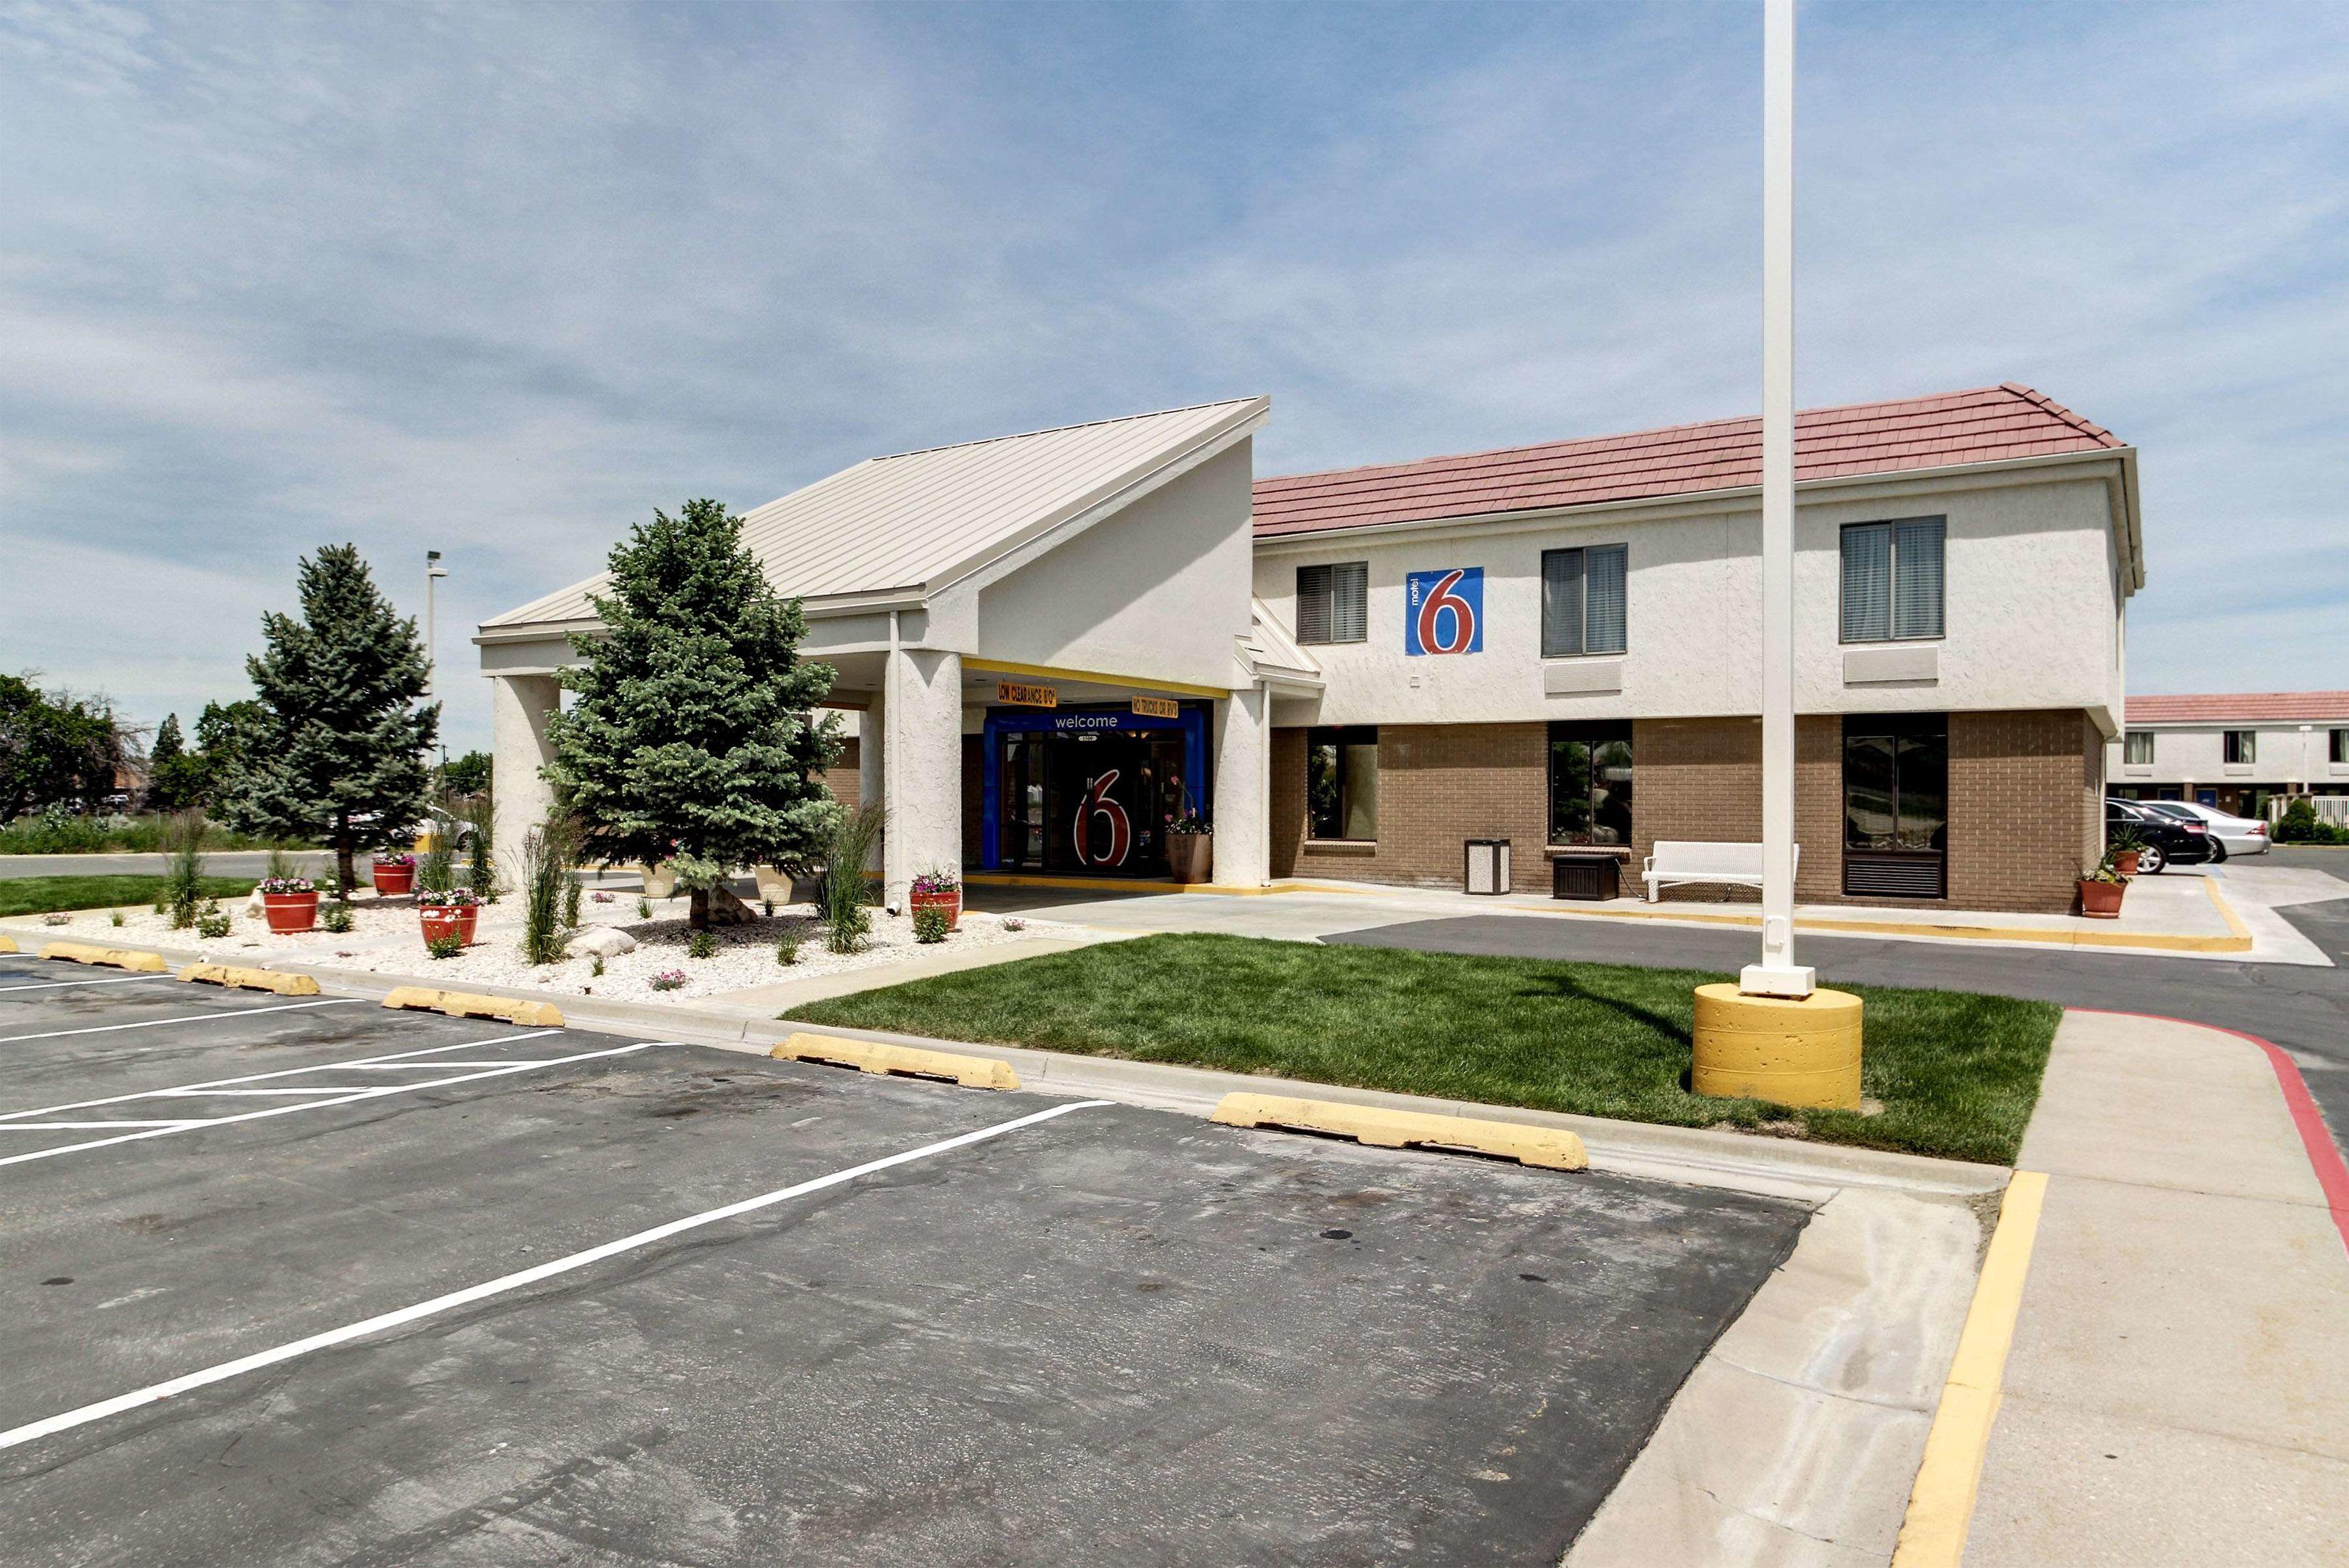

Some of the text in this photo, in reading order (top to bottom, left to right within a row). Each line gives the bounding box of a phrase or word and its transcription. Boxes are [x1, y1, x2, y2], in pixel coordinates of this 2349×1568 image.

[1418, 569, 1474, 655] 6
[999, 683, 1010, 701] LOW
[1012, 685, 1042, 703] CLEARANCE
[1133, 698, 1140, 712] NO
[1141, 699, 1158, 714] TRUCKS
[1159, 701, 1166, 714] OR
[1055, 715, 1117, 728] welcome
[1074, 769, 1130, 865] 6
